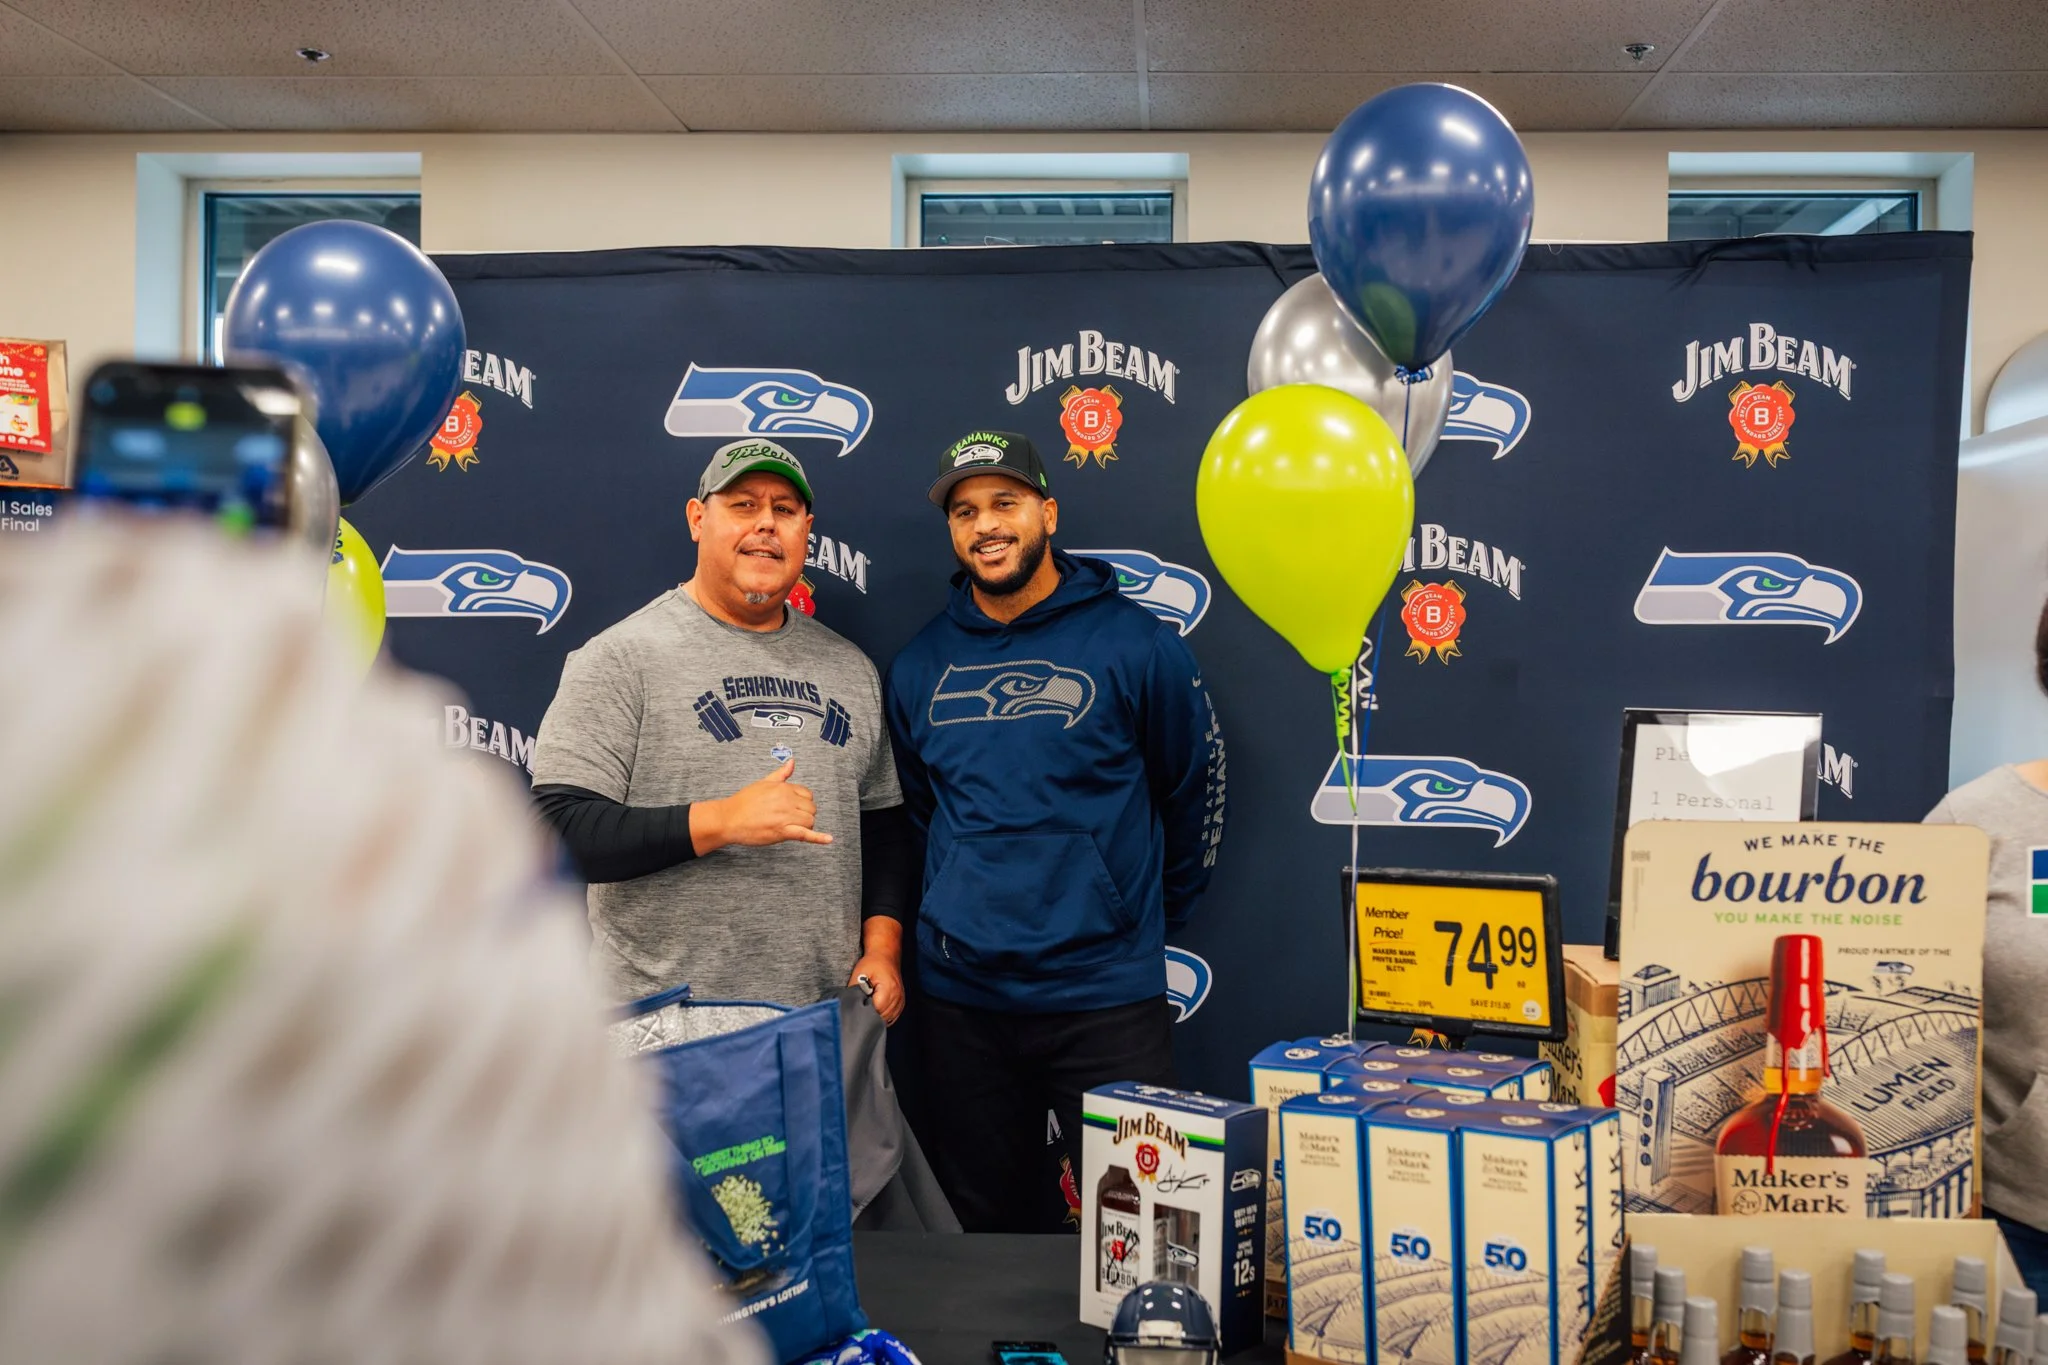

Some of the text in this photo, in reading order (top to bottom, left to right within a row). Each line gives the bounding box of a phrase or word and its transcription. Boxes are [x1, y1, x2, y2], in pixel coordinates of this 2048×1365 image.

[1005, 329, 1176, 405] JIM BEAM
[1672, 322, 1852, 402] JIM BEAM
[464, 349, 533, 409] EAM
[1083, 410, 1099, 428] B
[1753, 407, 1769, 425] B
[722, 443, 800, 470] Titleist
[950, 432, 1009, 458] SEAHAWKS
[11, 500, 52, 516] Sales
[2, 517, 39, 532] Final
[804, 532, 867, 594] EAM
[1420, 523, 1521, 600] BEAM
[1426, 606, 1441, 623] B
[722, 676, 821, 705] SEAHAWKS
[444, 705, 535, 777] BEAM
[1201, 730, 1217, 841] SEATTLE
[1651, 791, 1775, 811] 1 Personal
[1744, 833, 1885, 854] WE MAKE THE
[1692, 852, 1927, 904] bourbon
[1365, 906, 1409, 920] Member
[1714, 912, 1903, 926] YOU MAKE THE NOISE
[1373, 926, 1404, 939] Price!
[1372, 948, 1416, 957] MAKERS MARK
[1394, 957, 1418, 966] BARREL
[1838, 946, 1951, 956] PROUD PARTNER OF THE
[1470, 999, 1488, 1008] SAVE
[1851, 1056, 1952, 1112] LUMEN
[1902, 1078, 1956, 1111] FIELD
[1113, 1111, 1187, 1160] JIM BEAM
[1731, 1168, 1849, 1188] Maker's
[1763, 1193, 1848, 1214] Mark
[1304, 1215, 1342, 1241] 50
[1390, 1233, 1431, 1261] 50
[1484, 1242, 1527, 1271] 50
[1233, 1259, 1255, 1287] 12s
[718, 1296, 777, 1325] HINGTON'S
